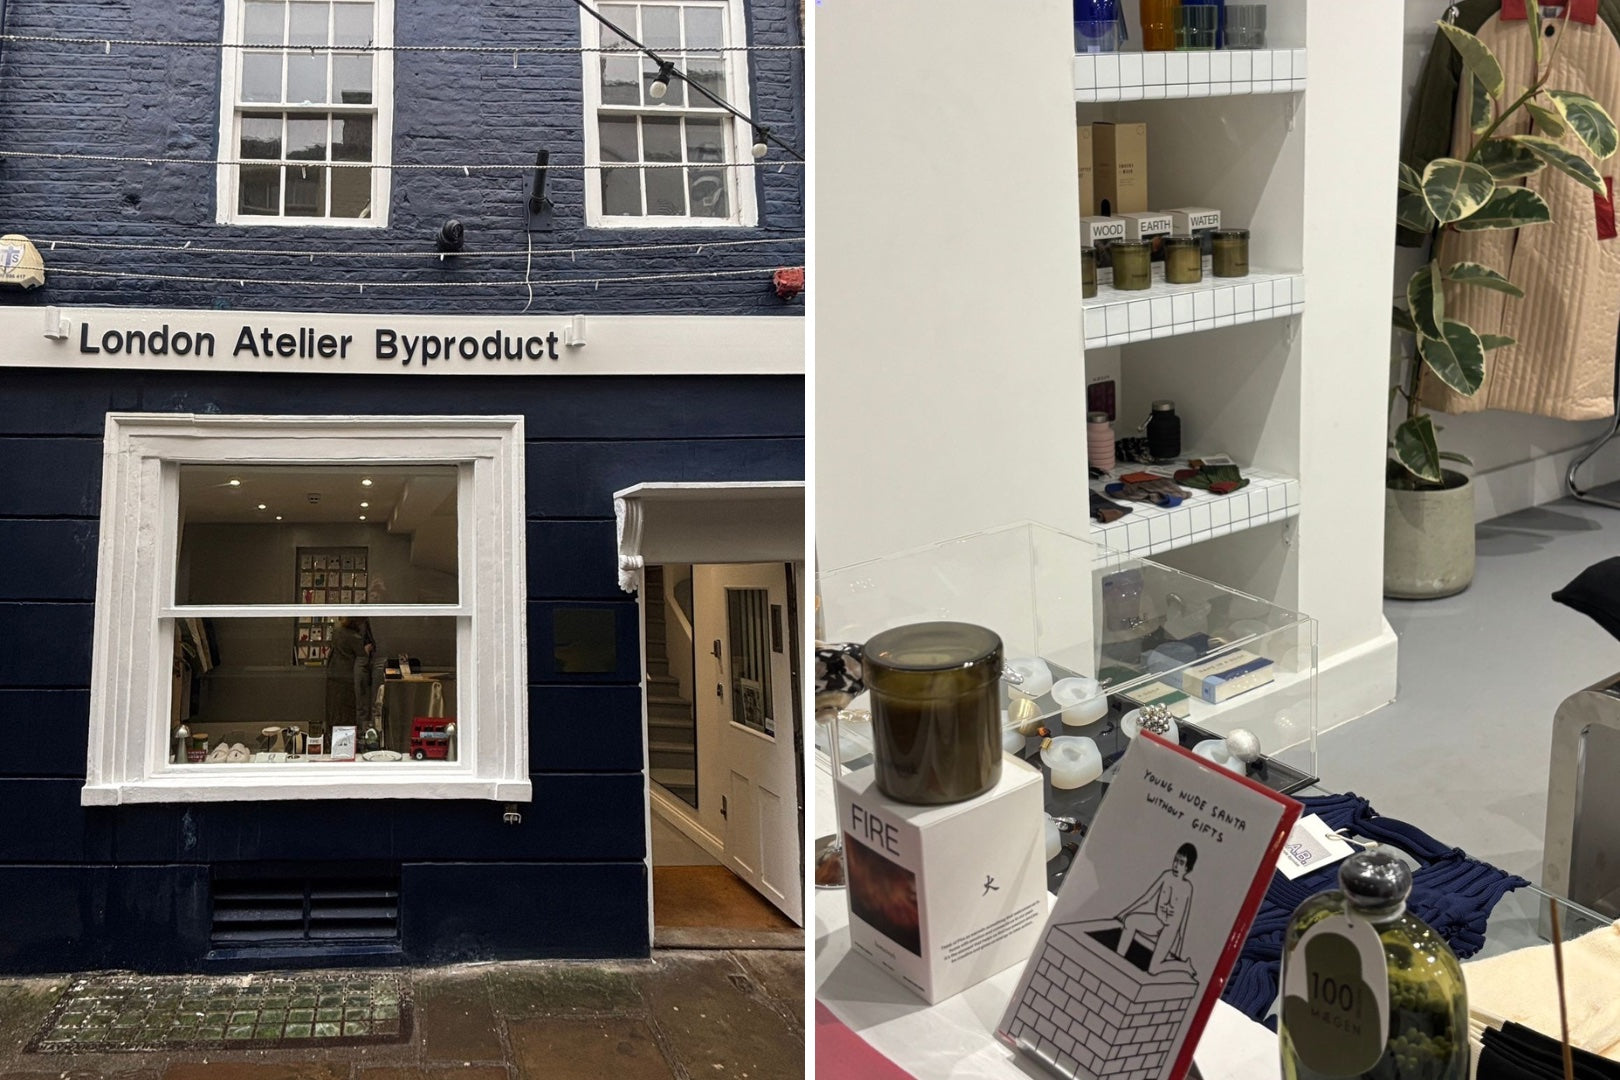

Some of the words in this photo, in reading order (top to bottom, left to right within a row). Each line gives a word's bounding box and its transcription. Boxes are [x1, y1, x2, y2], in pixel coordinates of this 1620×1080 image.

[1093, 223, 1123, 237] WOOD
[1140, 219, 1170, 232] EARTH
[1190, 214, 1219, 226] WATER
[80, 323, 215, 357] London
[233, 326, 353, 359] Atelier
[376, 329, 559, 366] Byproduct
[1144, 768, 1173, 792] YOUNG
[1179, 790, 1207, 811] NUDE
[1210, 805, 1247, 832] SANTA
[1146, 793, 1184, 821] WITHOUT
[1192, 818, 1224, 843] GIFTS
[851, 803, 900, 857] FIRE
[1311, 972, 1354, 1012] 100
